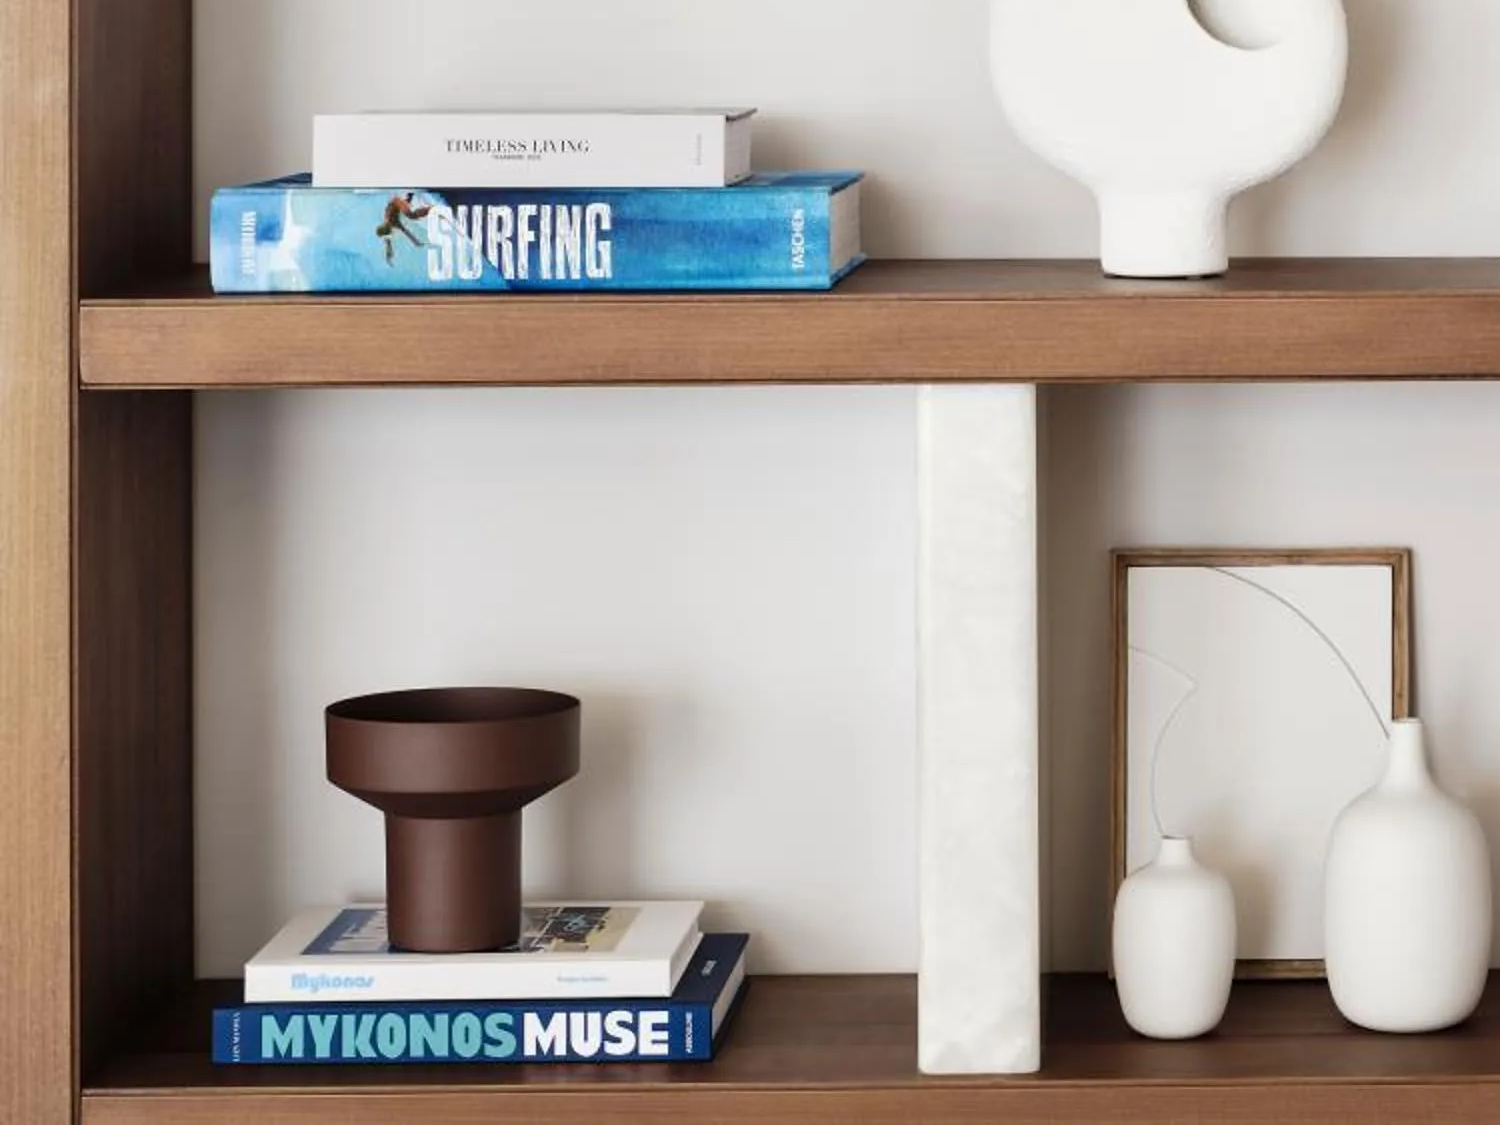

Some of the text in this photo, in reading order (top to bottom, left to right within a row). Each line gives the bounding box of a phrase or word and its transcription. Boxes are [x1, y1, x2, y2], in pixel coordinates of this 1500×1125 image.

[446, 139, 590, 153] TIMELESS LIVING
[426, 202, 613, 281] SURFING
[791, 208, 805, 269] TASCHEN
[261, 1012, 515, 1060] MYKONOS
[523, 1009, 670, 1056] MUSE
